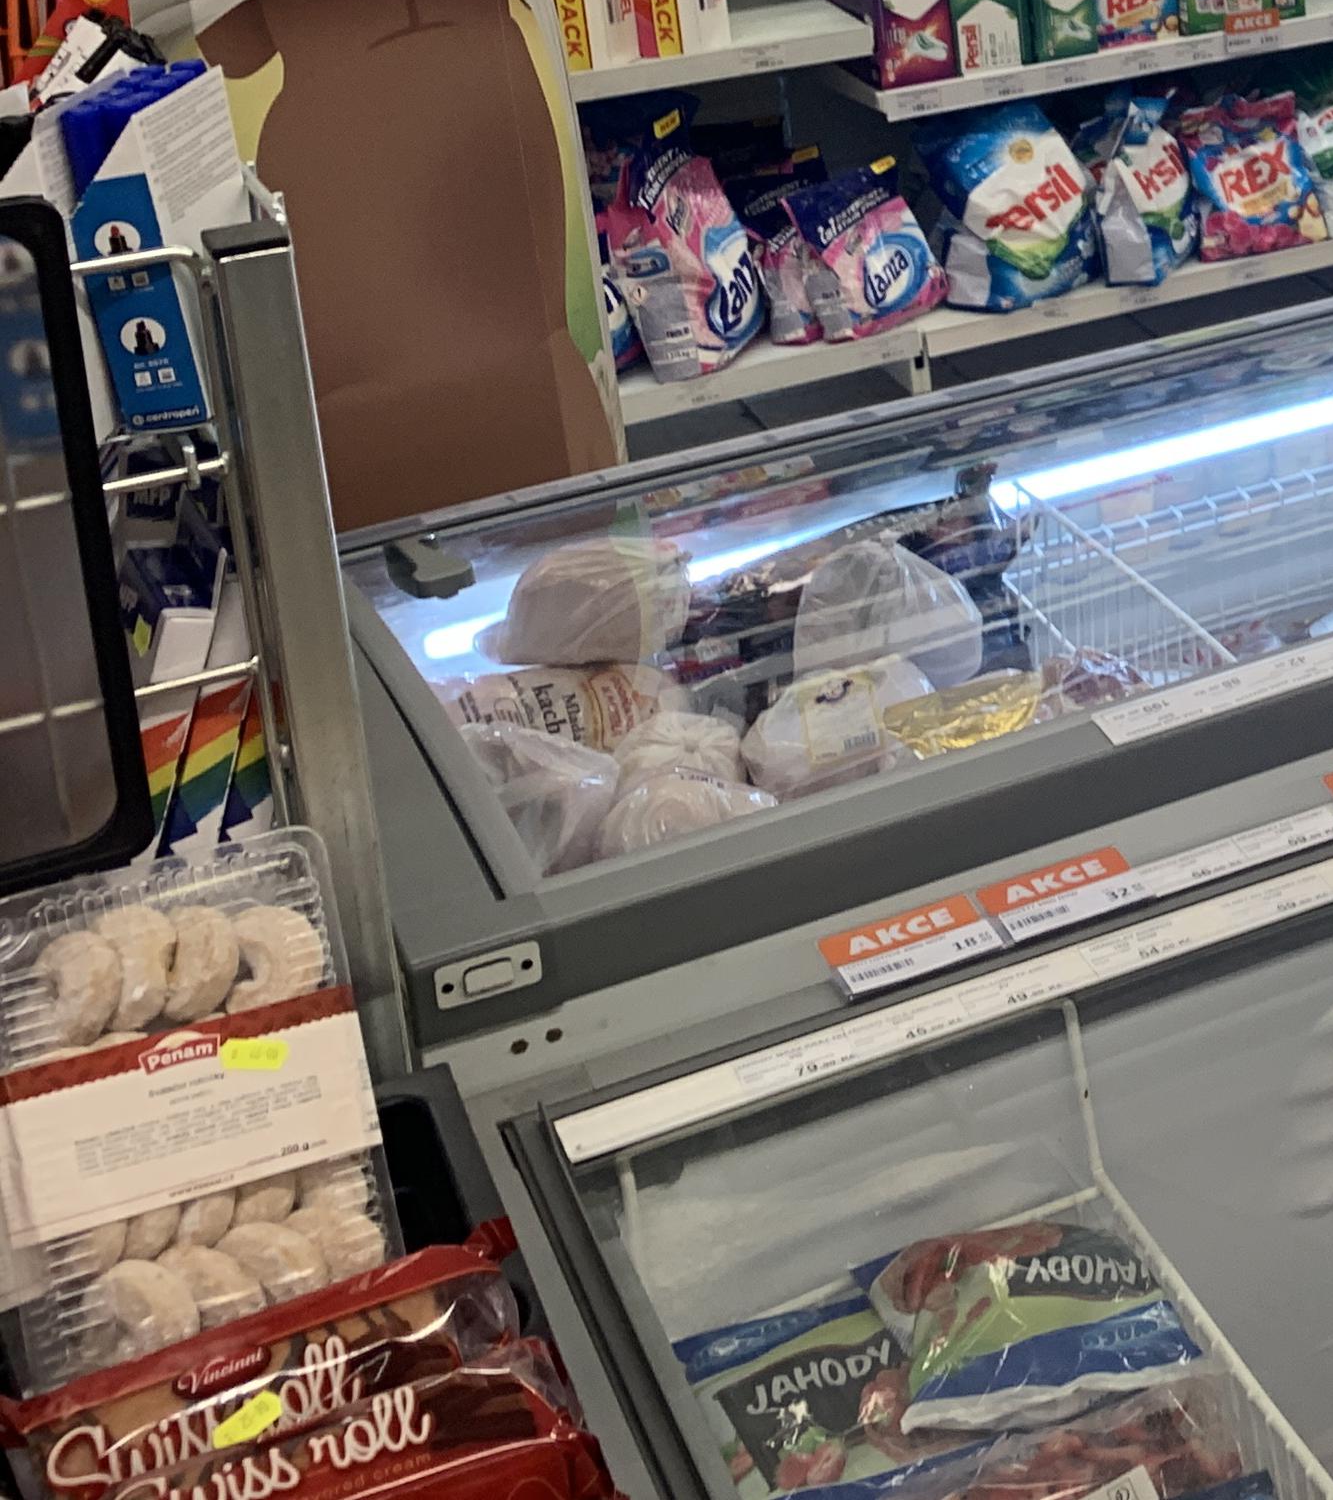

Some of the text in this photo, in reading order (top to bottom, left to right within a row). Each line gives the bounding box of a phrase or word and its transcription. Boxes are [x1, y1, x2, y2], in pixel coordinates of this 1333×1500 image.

[1234, 14, 1271, 29] AKCE
[962, 23, 981, 72] Persil
[1221, 139, 1289, 203] REX
[868, 251, 908, 306] Lanza
[1007, 859, 1106, 904] AKCE
[848, 909, 952, 954] AKCE
[147, 1042, 212, 1070] Penam
[1025, 1253, 1150, 1285] JAHODY
[178, 1349, 263, 1393] Vincinni
[746, 1337, 894, 1416] JAHODY
[311, 1386, 432, 1468] roll
